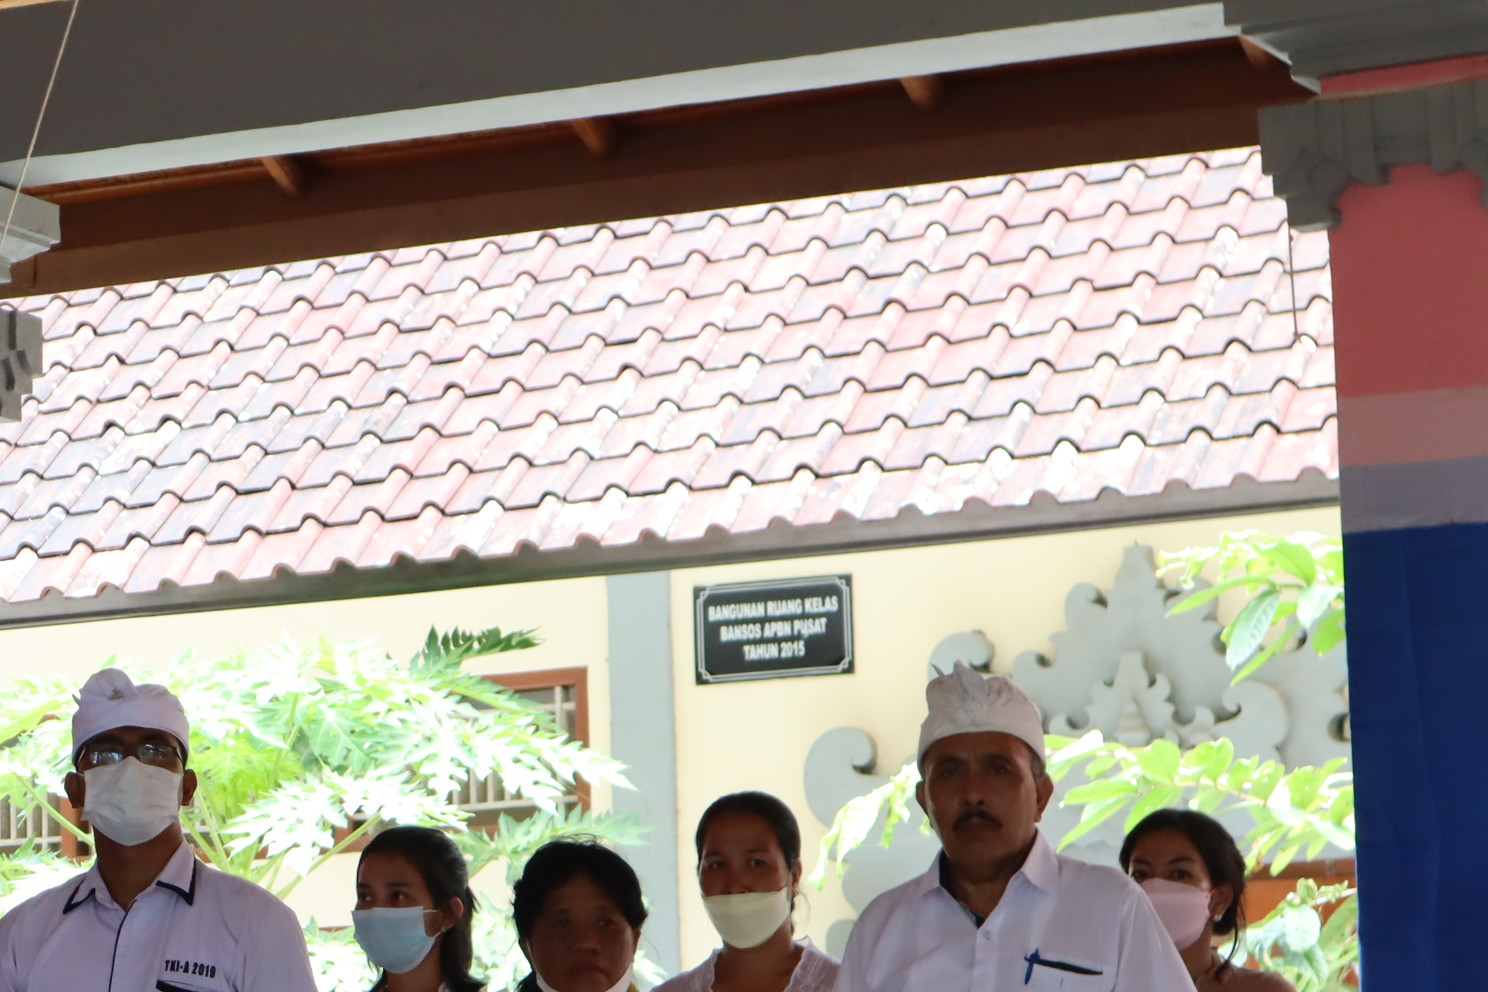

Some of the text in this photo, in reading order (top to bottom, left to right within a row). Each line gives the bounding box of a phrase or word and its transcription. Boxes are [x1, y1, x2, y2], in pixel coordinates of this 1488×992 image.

[708, 596, 838, 621] BANGUNAN RUANG KELAS
[720, 617, 827, 641] BANSOS APBN PUSAT
[743, 640, 805, 661] TAHUN 2015
[165, 960, 216, 978] TKI-A 2019
